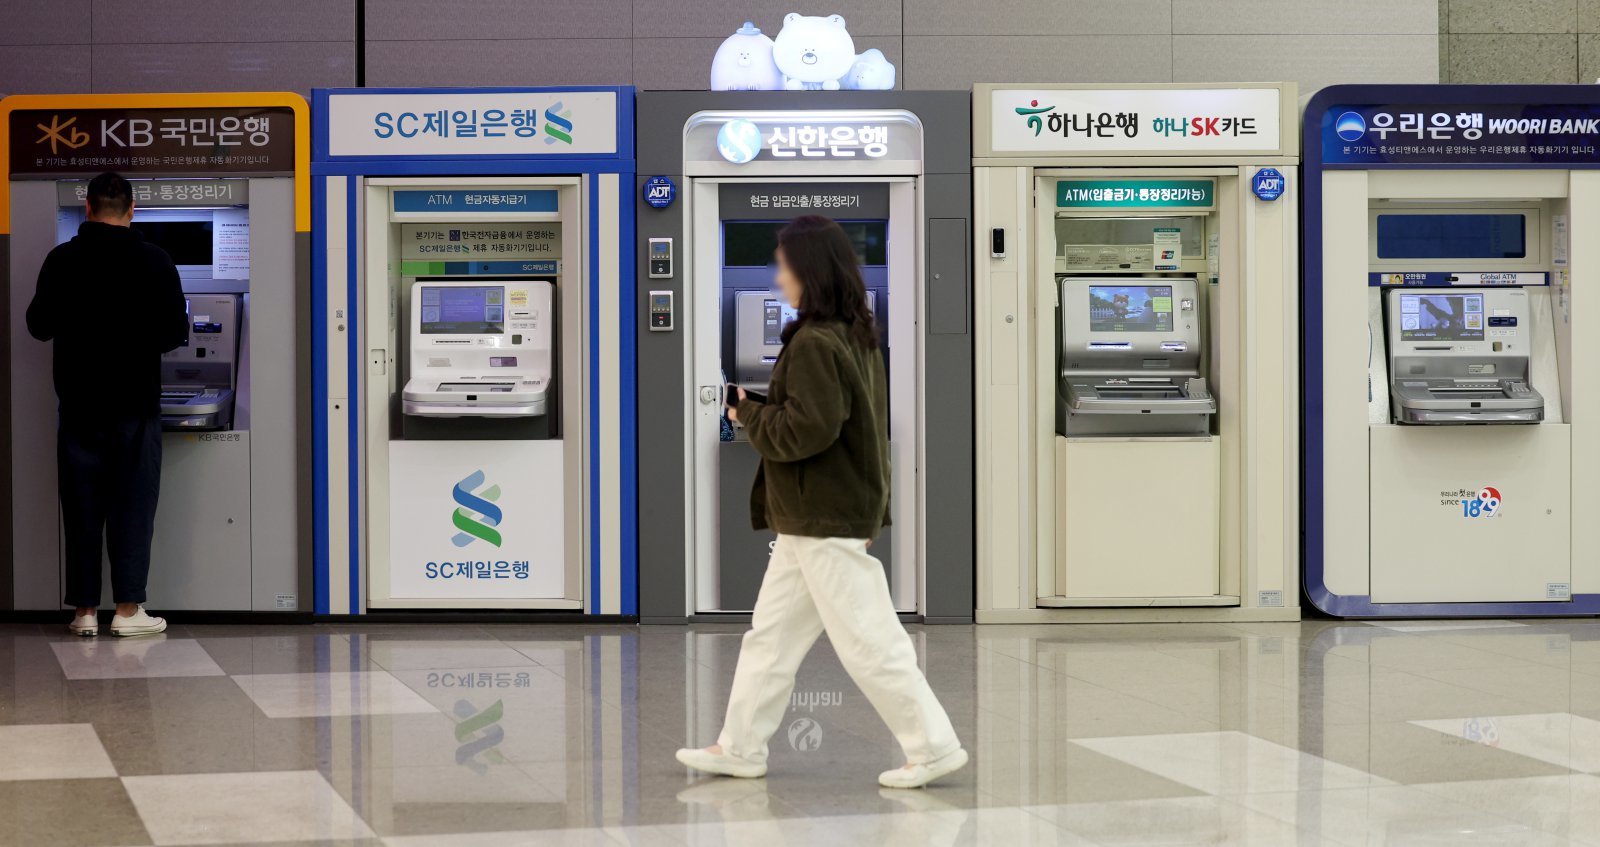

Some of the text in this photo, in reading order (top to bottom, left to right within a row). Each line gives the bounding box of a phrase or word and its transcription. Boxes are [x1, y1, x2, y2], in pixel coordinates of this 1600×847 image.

[374, 109, 537, 139] SC제일은행
[1047, 111, 1258, 139] 하나은행 하나SK카드
[1369, 112, 1600, 141] 우리은행 WOORI BANK
[767, 125, 889, 158] 신한은행
[1342, 145, 1351, 155] 본
[1353, 145, 1377, 155] 기기는
[1445, 145, 1477, 155] 운영하는
[36, 157, 44, 166] 본
[46, 157, 68, 166] 기기는
[131, 156, 161, 165] 운영하는
[1258, 179, 1279, 190] ADT
[648, 186, 670, 198] ADT
[427, 194, 527, 205] ATM 현금자동지급기
[750, 194, 860, 209] 현금 입금인출/통장정리기
[525, 230, 555, 239] 운영하는
[419, 244, 461, 253] SC제일은행
[472, 244, 488, 253] 제휴
[1480, 273, 1501, 281] Global
[425, 560, 529, 580] SC제일은행
